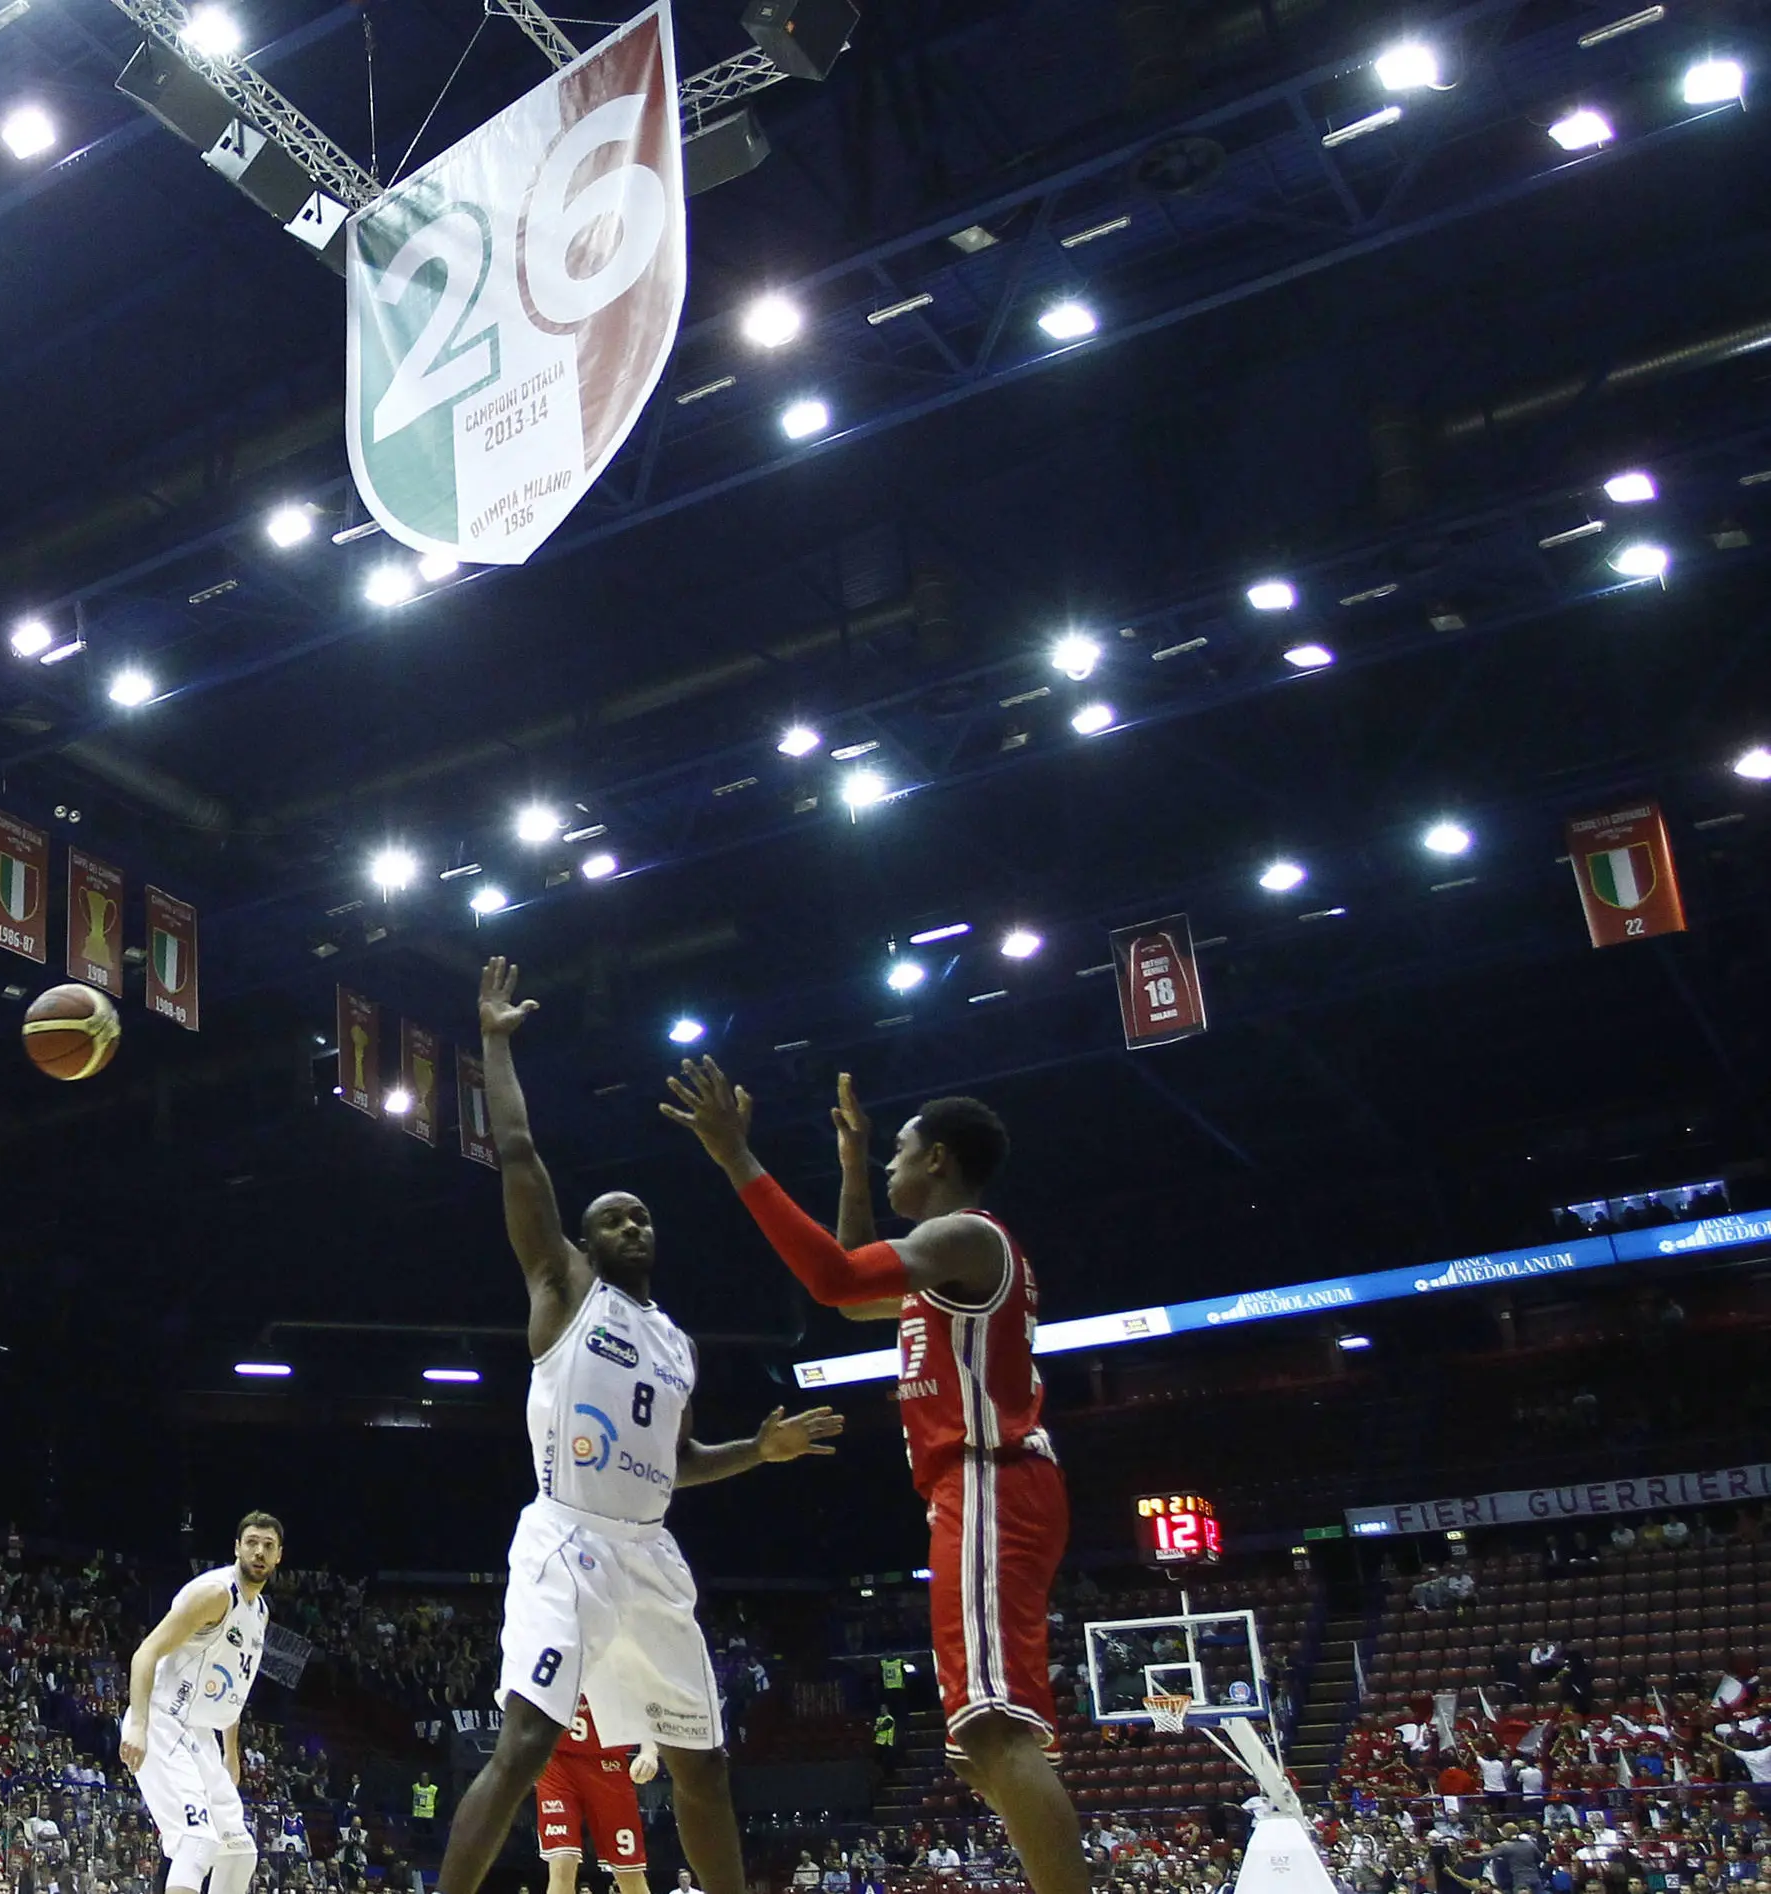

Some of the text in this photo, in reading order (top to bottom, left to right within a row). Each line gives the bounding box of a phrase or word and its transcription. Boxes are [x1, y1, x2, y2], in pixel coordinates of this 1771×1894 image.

[374, 93, 665, 443] 26
[465, 360, 566, 433] CAMPIONI D'ITALIA
[484, 394, 549, 452] 2013-14
[470, 469, 572, 539] OLIMPIA MILANO
[504, 504, 535, 537] 1936
[1625, 917, 1645, 936] 22
[1144, 977, 1176, 1008] 18
[1703, 1215, 1745, 1230] BANCA
[1454, 1255, 1492, 1270] BANCA
[1457, 1252, 1575, 1283] MEDIOLANUM
[1243, 1290, 1278, 1304] BANCA
[1245, 1287, 1354, 1316] MEDIOLANUM
[632, 1381, 656, 1428] 8
[1393, 1468, 1771, 1531] FIERI GUERRIERI
[1156, 1513, 1199, 1550] 12
[532, 1646, 563, 1688] 8
[569, 1716, 589, 1742] 9
[184, 1803, 209, 1827] 24
[615, 1828, 636, 1857] 9
